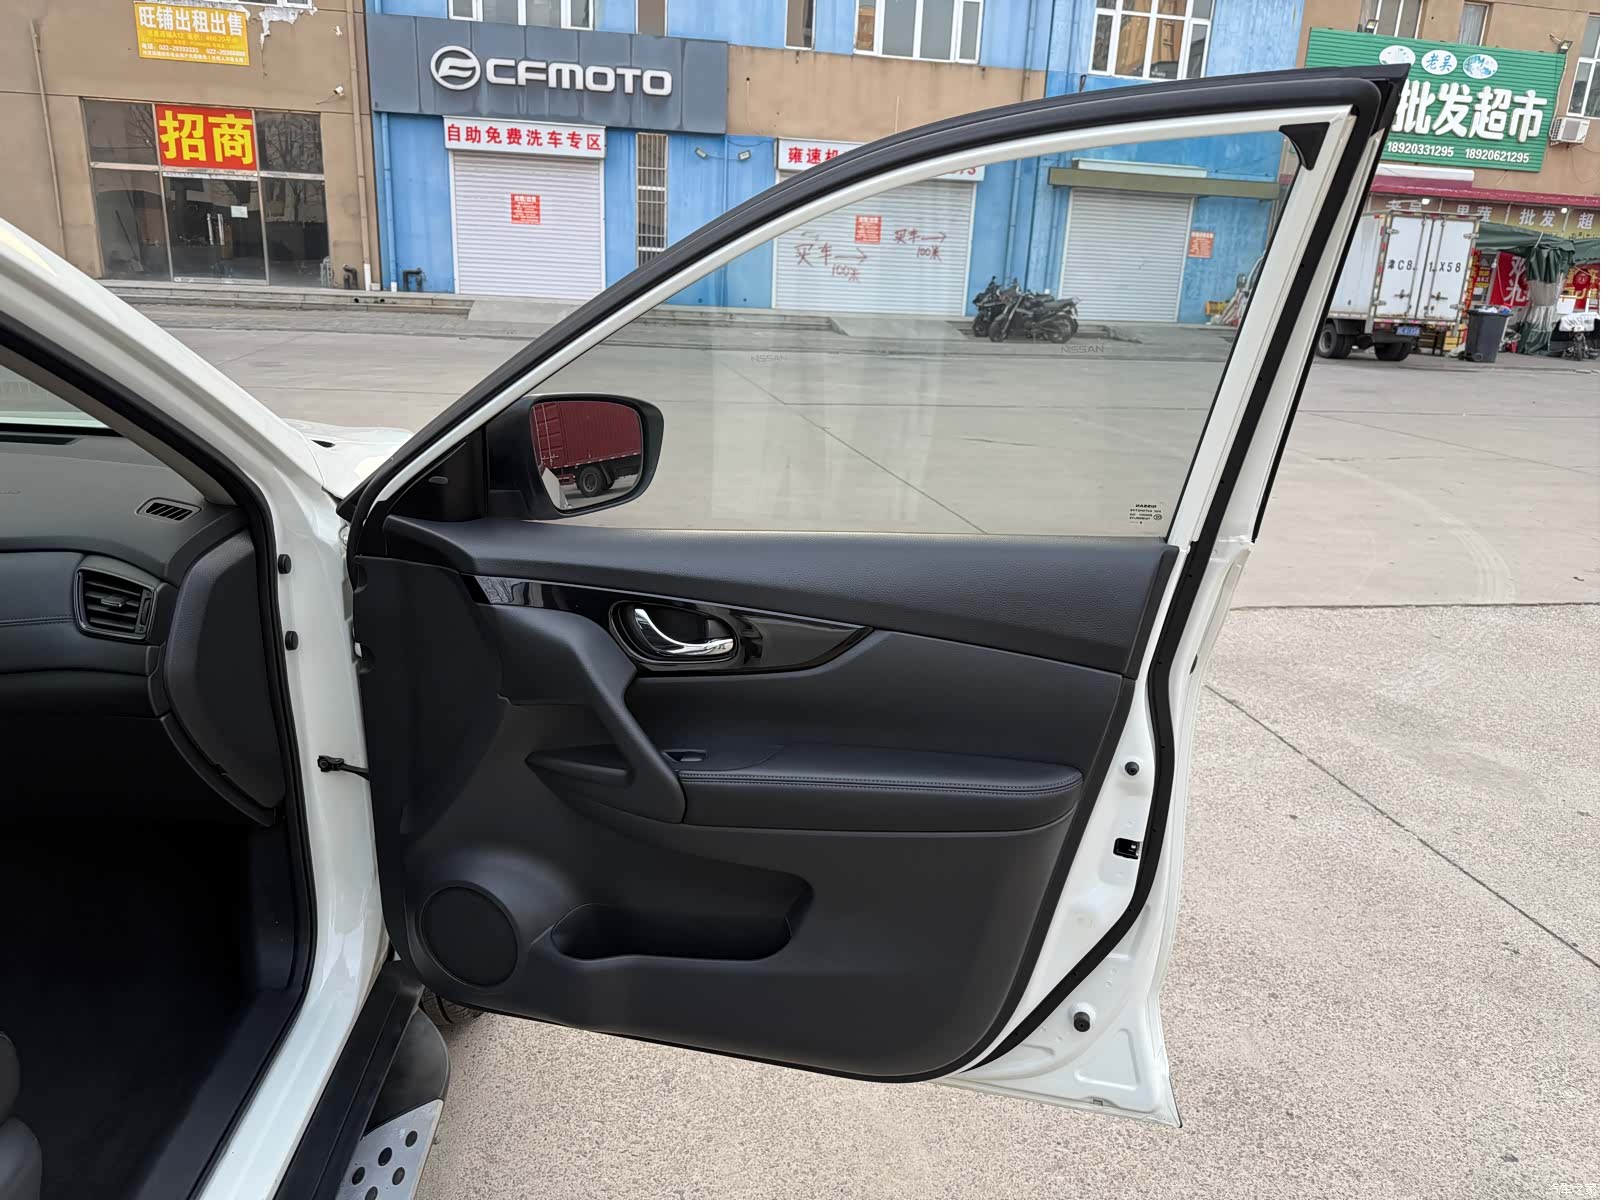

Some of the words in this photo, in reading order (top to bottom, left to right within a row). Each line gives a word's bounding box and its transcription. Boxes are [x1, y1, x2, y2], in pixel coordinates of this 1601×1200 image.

[138, 6, 243, 36] 旺铺出租出售
[486, 58, 672, 96] CFMOTO
[1426, 53, 1453, 71] 老吴
[1391, 79, 1547, 143] 批发超市
[159, 110, 254, 165] 招商
[447, 123, 602, 151] 自助免费洗车专区
[1387, 141, 1454, 157] 18920331295
[1465, 148, 1530, 163] 18920621295
